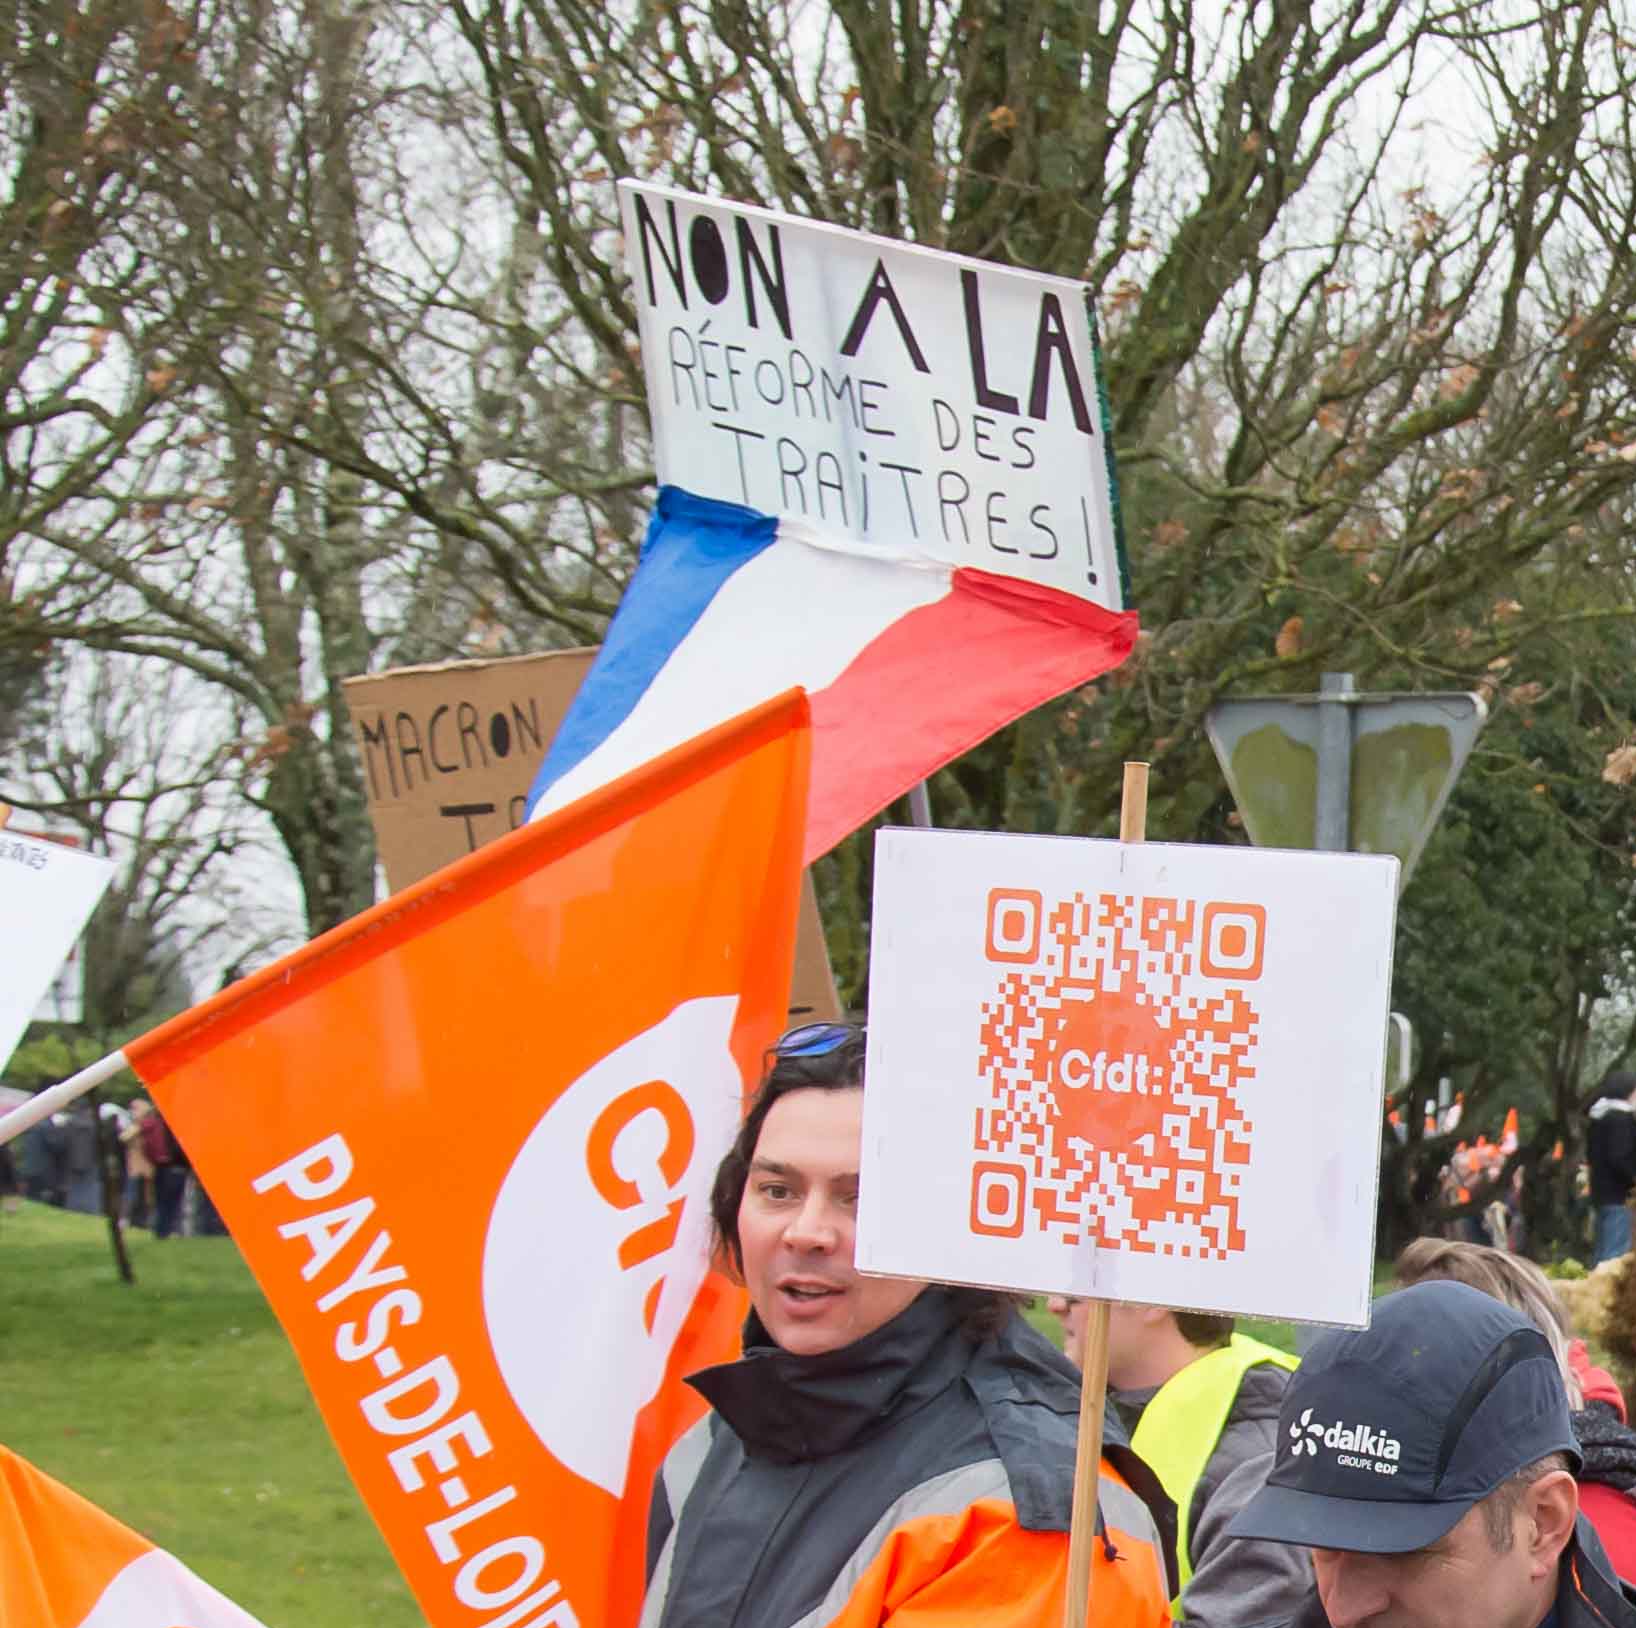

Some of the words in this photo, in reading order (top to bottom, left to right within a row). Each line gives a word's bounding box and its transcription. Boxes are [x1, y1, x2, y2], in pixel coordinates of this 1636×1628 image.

[634, 193, 793, 340] NON
[960, 268, 1093, 435] LA
[933, 399, 1037, 470] DES
[360, 697, 542, 801] MACRON
[1060, 1049, 1163, 1095] Cfdt:
[1324, 1421, 1401, 1461] dalkia
[1338, 1455, 1372, 1470] GROUPE
